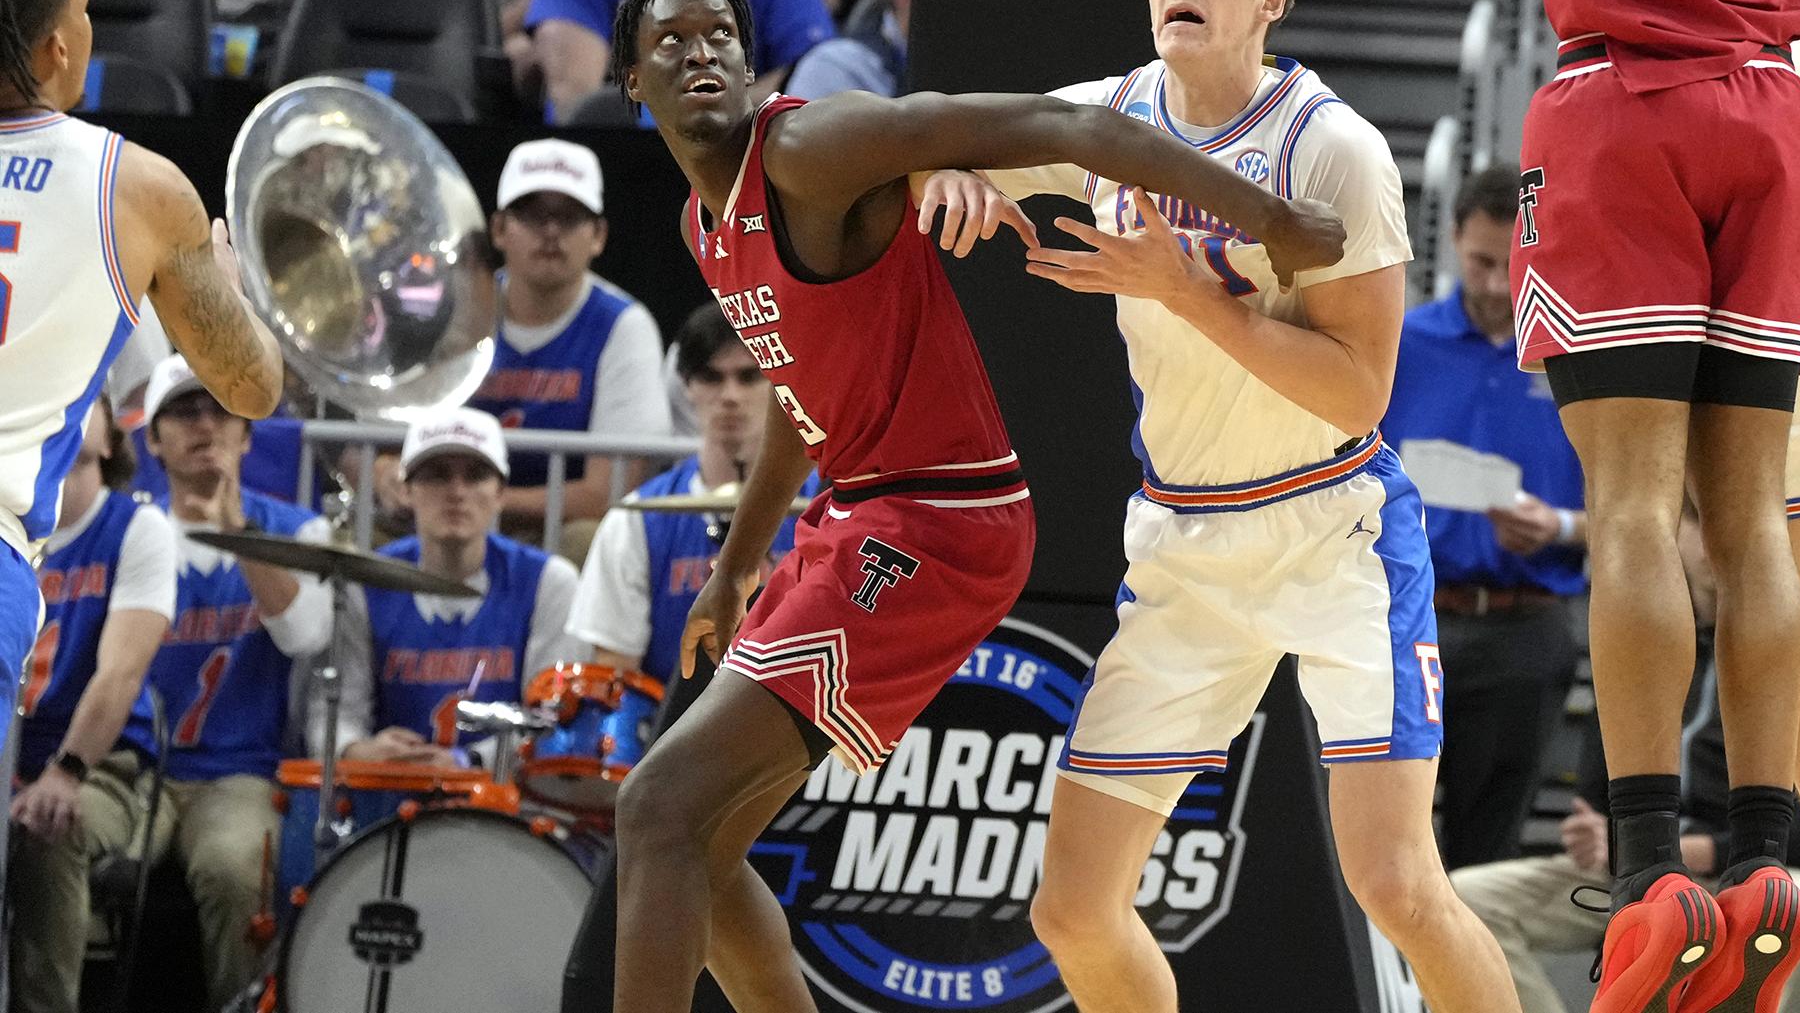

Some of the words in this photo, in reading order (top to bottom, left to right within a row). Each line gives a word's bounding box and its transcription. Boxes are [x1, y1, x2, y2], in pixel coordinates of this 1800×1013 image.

[997, 652, 1039, 690] 16
[1413, 641, 1443, 724] F
[883, 960, 973, 1002] ELITE
[981, 968, 1004, 998] 8
